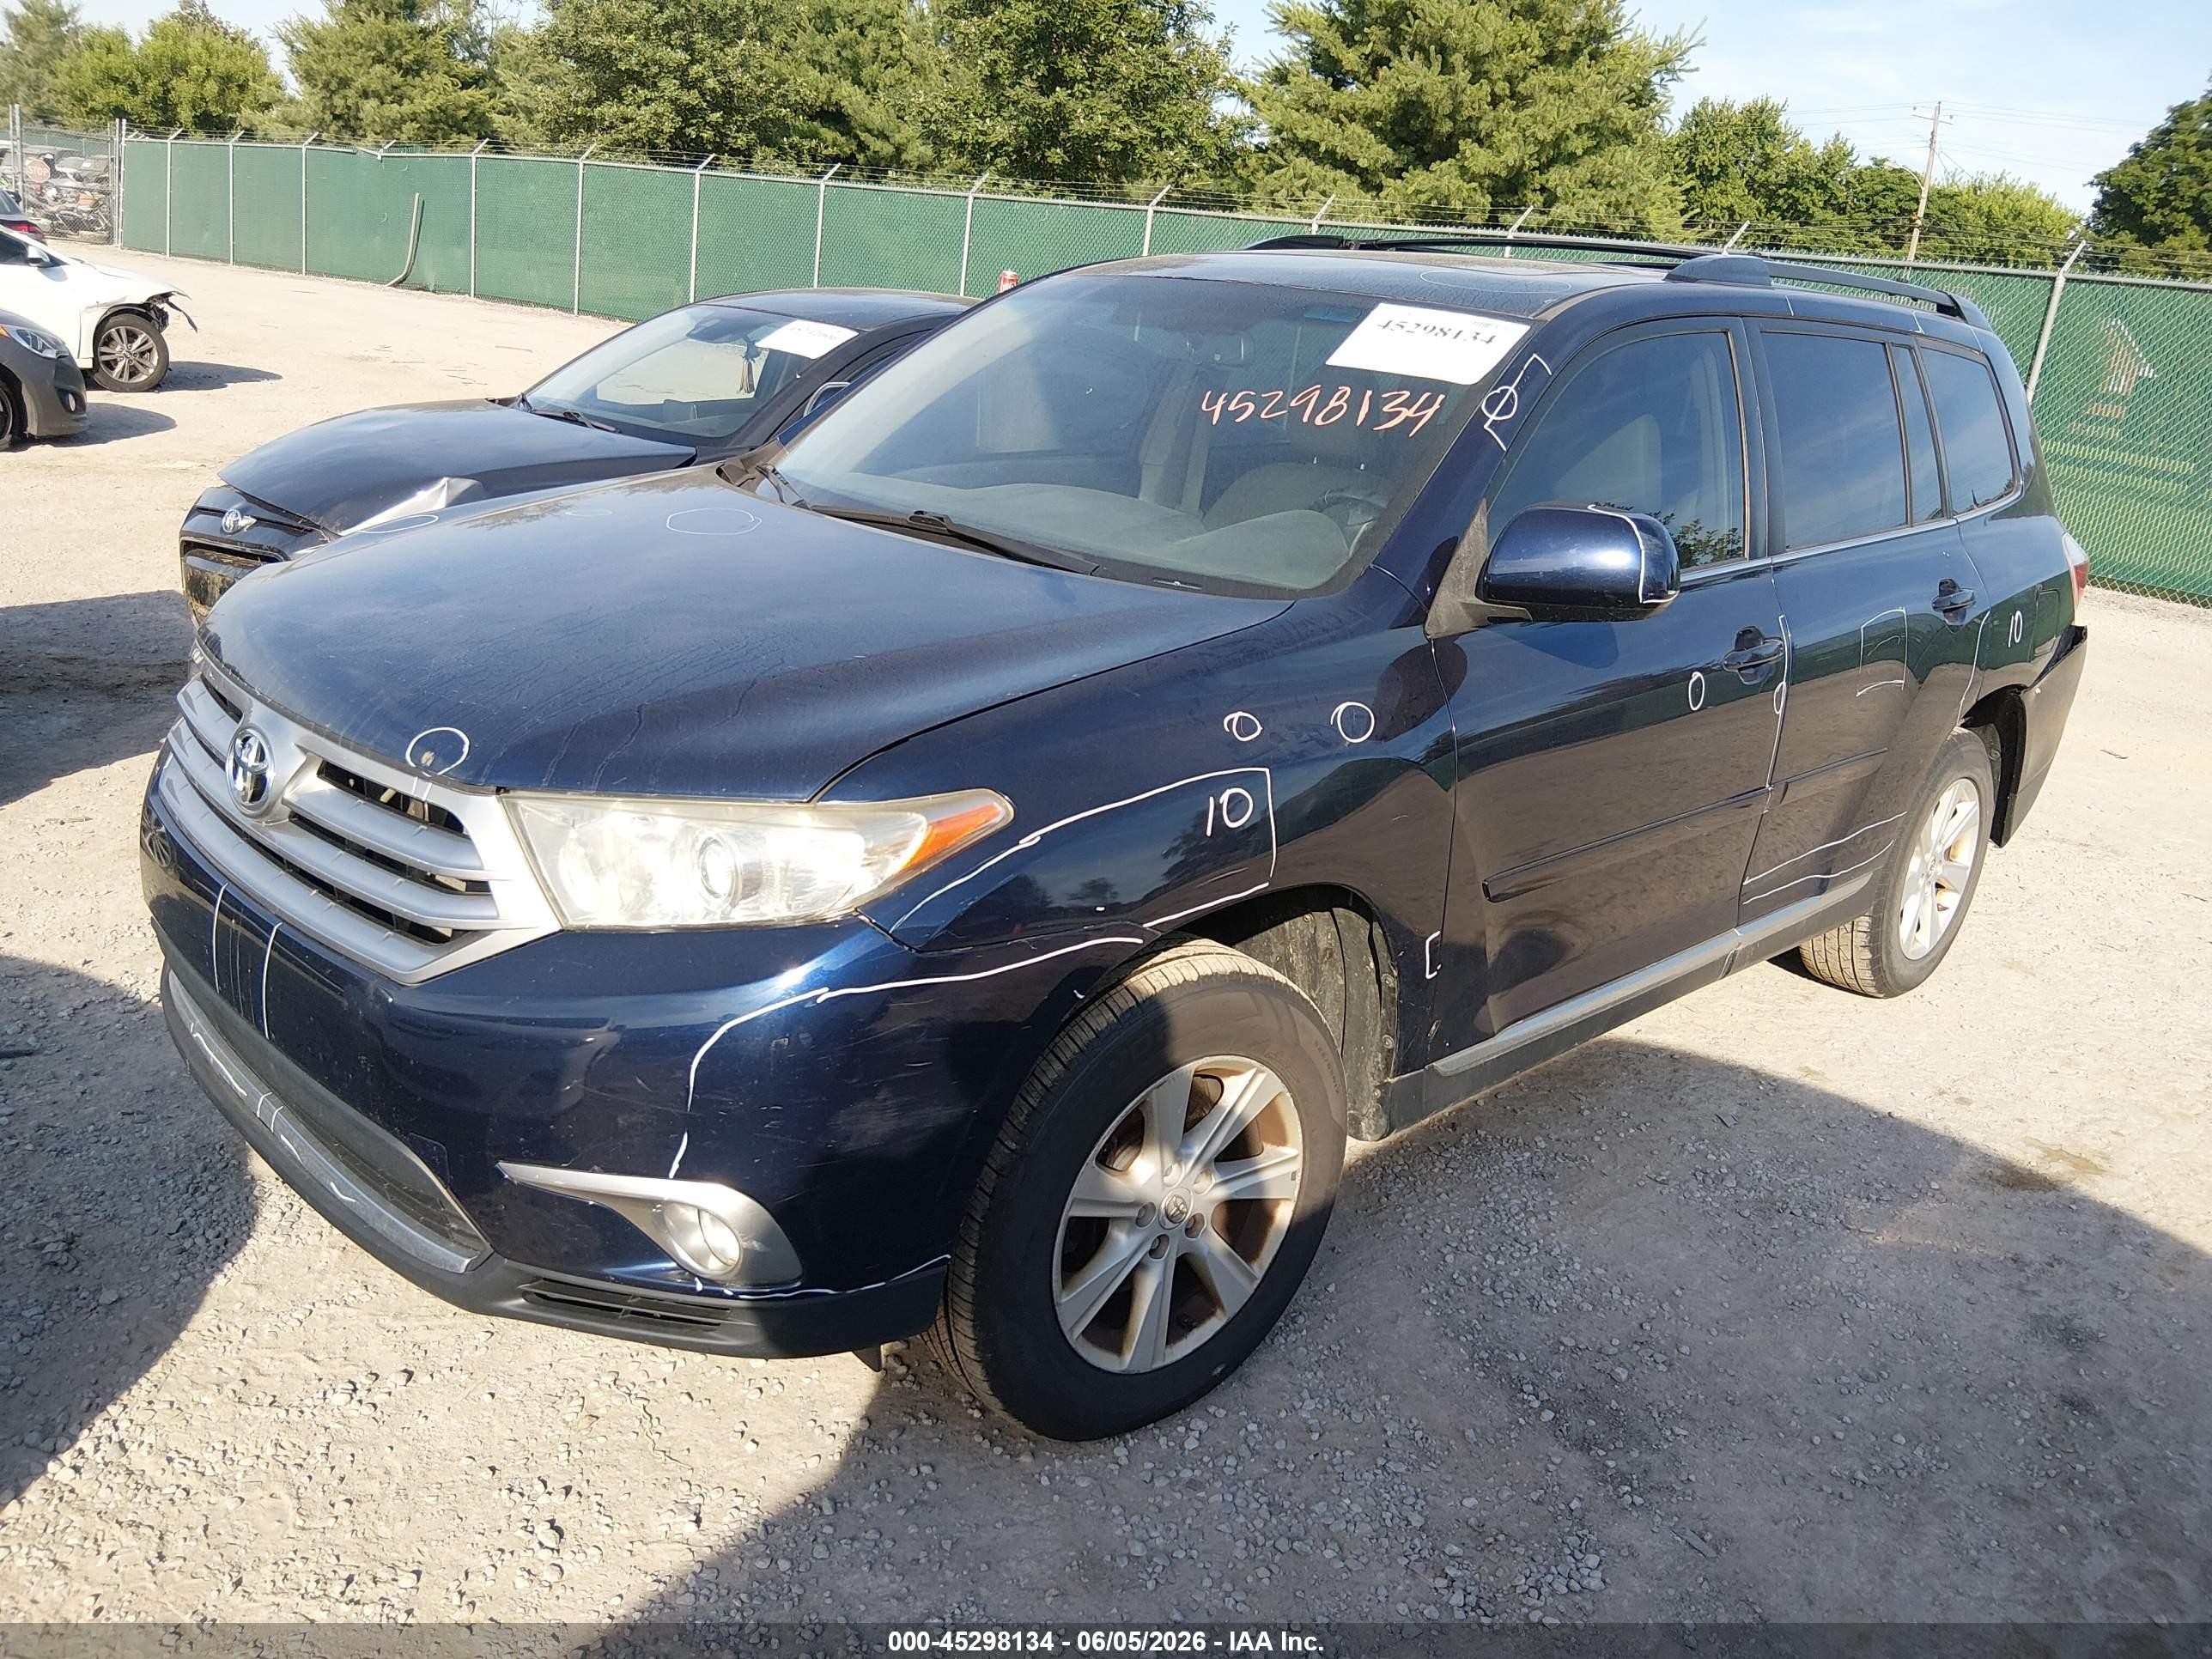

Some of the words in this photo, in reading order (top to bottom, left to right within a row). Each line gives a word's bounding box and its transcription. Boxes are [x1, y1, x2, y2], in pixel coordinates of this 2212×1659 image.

[27, 166, 49, 175] STOP
[1201, 384, 1446, 437] 45298134
[2008, 610, 2023, 648] 10
[1206, 787, 1254, 837] 10
